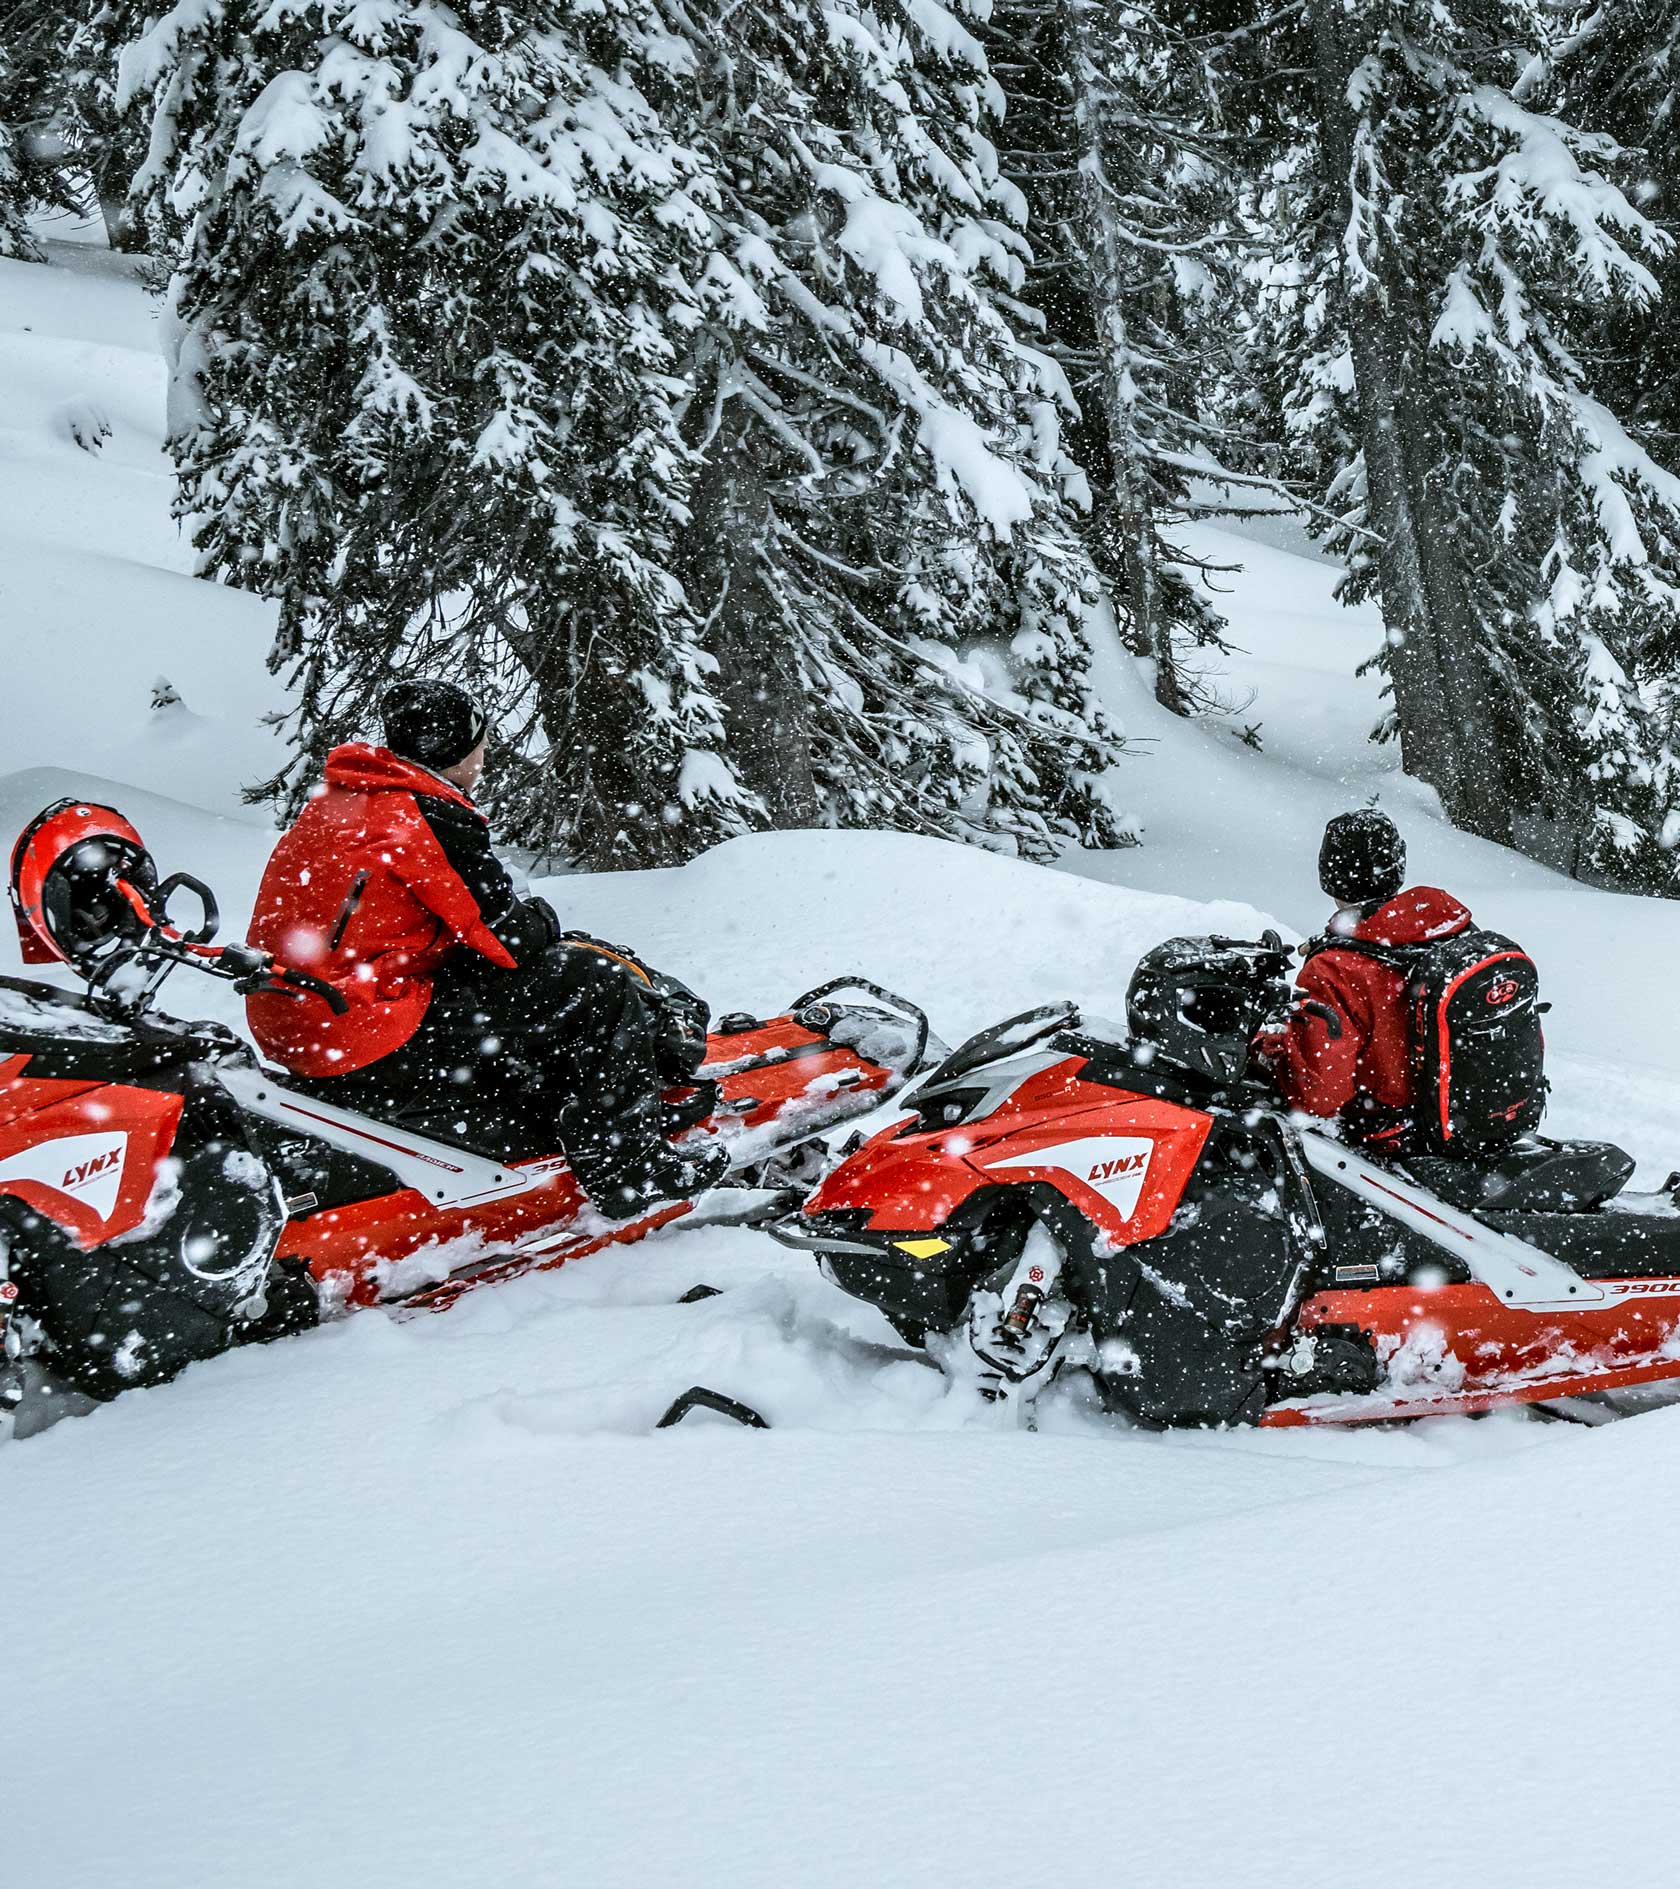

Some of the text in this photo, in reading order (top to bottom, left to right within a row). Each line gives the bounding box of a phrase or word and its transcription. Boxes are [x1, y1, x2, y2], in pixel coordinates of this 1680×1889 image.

[62, 1146, 123, 1187] LYNX
[531, 1160, 567, 1176] 39
[1088, 1152, 1149, 1181] LYNX
